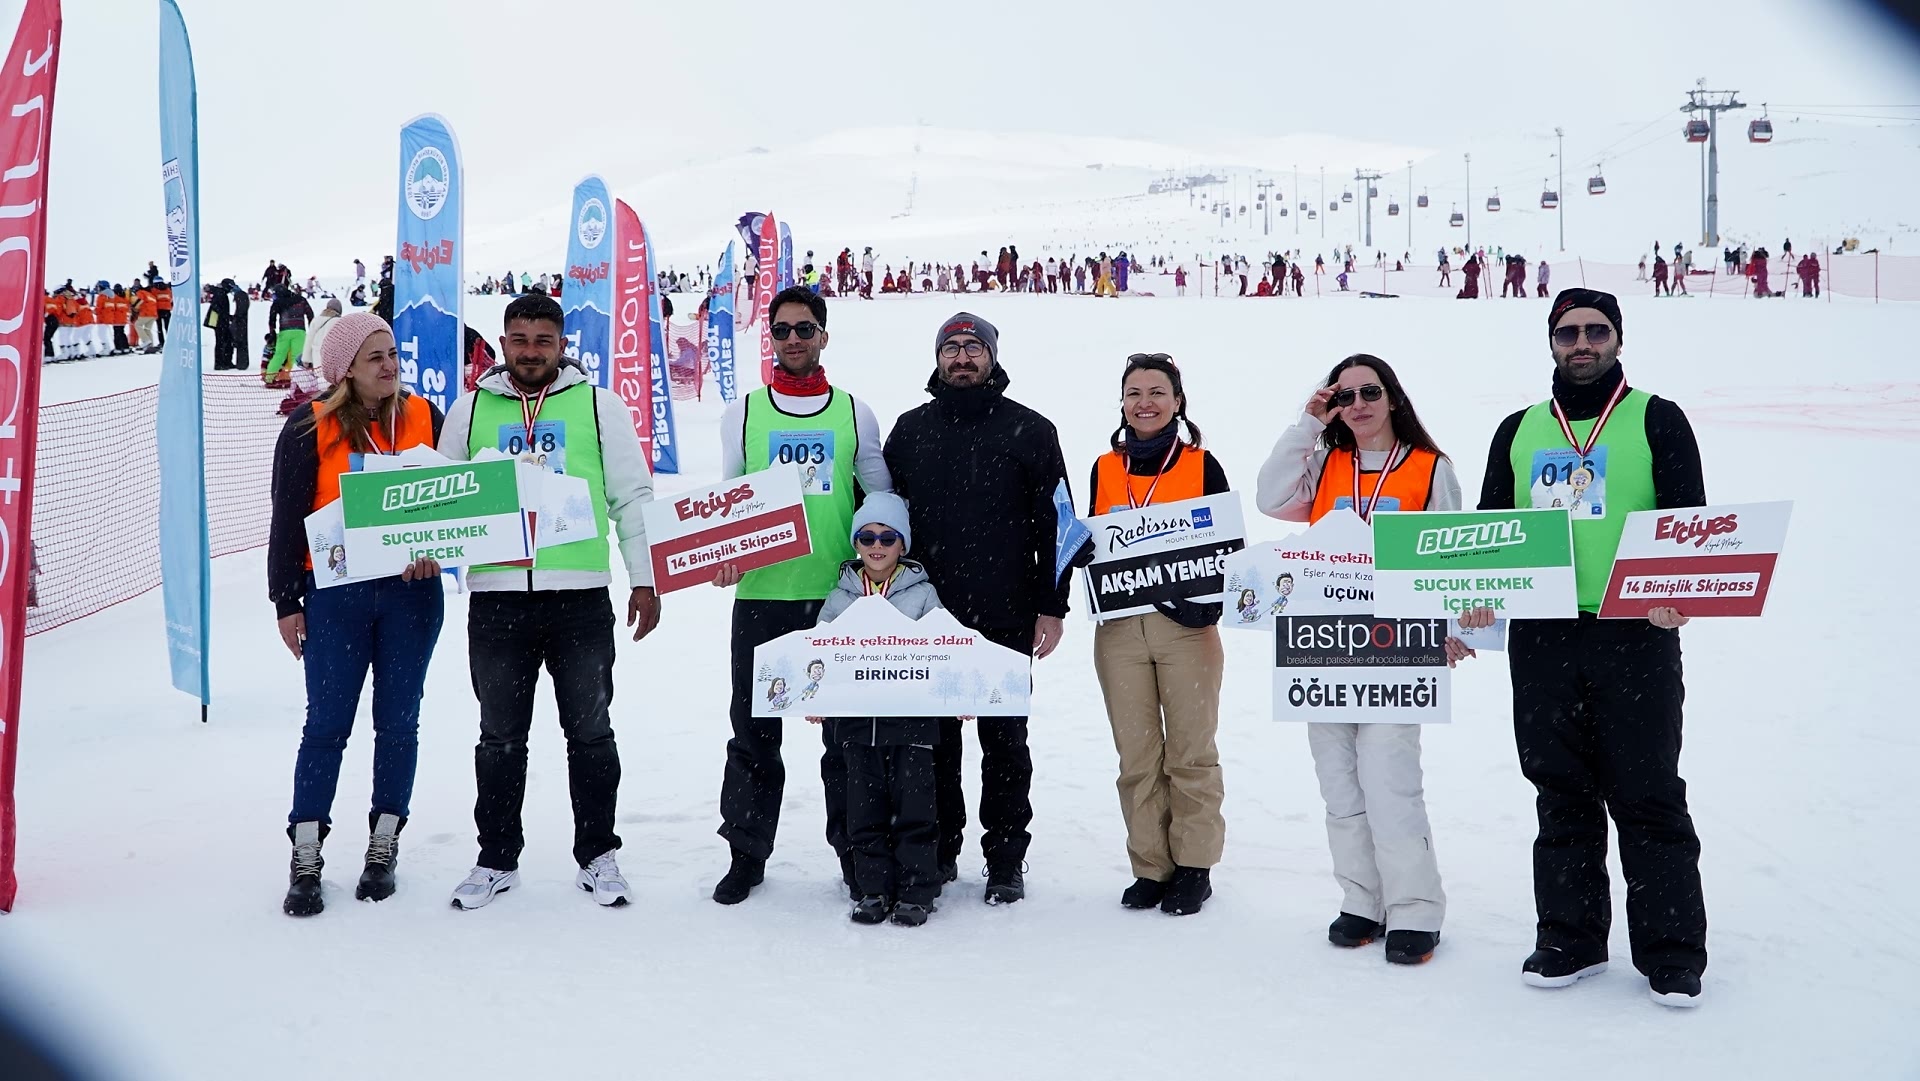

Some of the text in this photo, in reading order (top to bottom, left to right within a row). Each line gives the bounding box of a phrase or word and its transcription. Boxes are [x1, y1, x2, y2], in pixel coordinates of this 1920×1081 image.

[509, 432, 556, 455] 018
[779, 442, 825, 465] 003
[382, 470, 480, 511] BUZULL
[674, 483, 754, 522] Erciyes
[382, 524, 488, 546] SUCUK EKMEK
[1105, 514, 1211, 554] Radisson BLU
[1165, 535, 1188, 545] MOUNT
[1416, 519, 1527, 555] BUZULL
[1655, 513, 1738, 548] Erciyes
[671, 529, 793, 569] 14 Binişlik Skipass
[1100, 547, 1233, 596] AKŞAM YEMEĞ
[1303, 567, 1326, 578] Eşler
[1328, 570, 1352, 579] Arası
[1323, 584, 1374, 602] ÜÇÜN
[1413, 577, 1534, 592] SUCUK EKMEK
[1626, 578, 1754, 596] 14 Binişlik Skipass
[1443, 595, 1505, 614] İÇECEK
[860, 635, 929, 648] çekilmez
[1288, 616, 1440, 656] lastpoint
[834, 653, 951, 663] Eşler Arası Kızak Yarışması
[1286, 655, 1323, 665] breakfast
[1326, 655, 1364, 666] patisserie
[1412, 655, 1440, 664] coffee
[854, 667, 930, 680] BİRİNCİSİ
[1288, 677, 1437, 708] ÖĞLE YEMEĞİ
